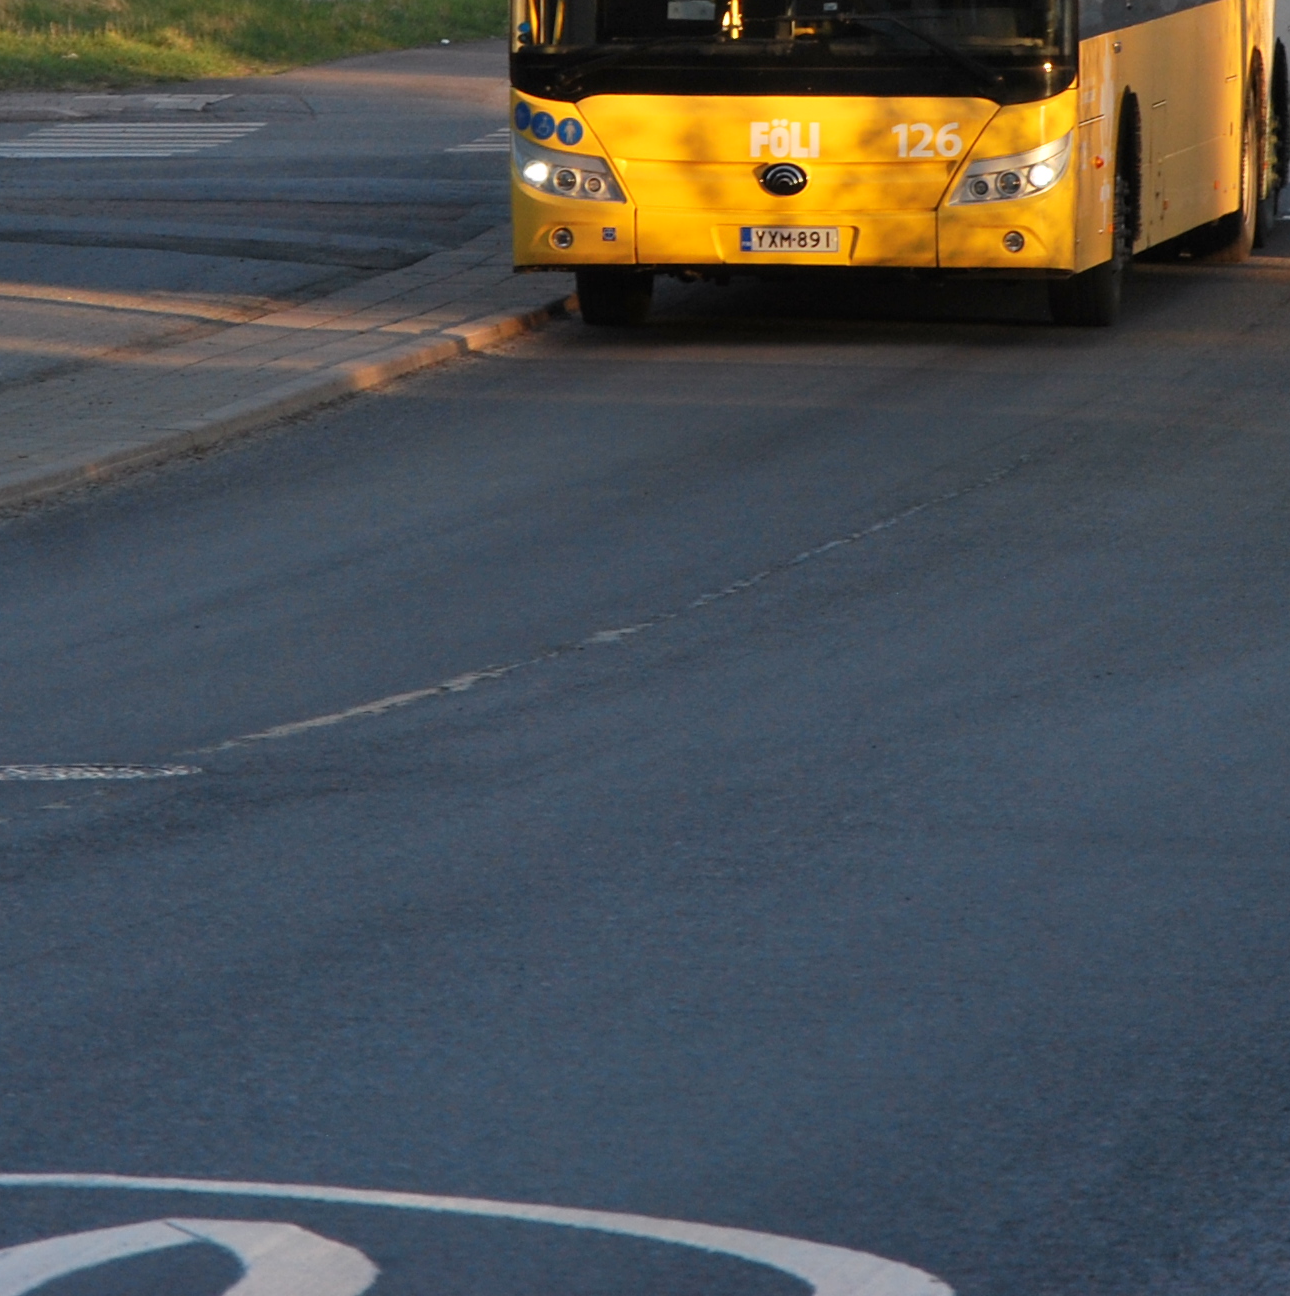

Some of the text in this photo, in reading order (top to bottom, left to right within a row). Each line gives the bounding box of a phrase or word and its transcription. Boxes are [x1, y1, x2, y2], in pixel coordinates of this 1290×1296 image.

[750, 118, 821, 159] FÖLI
[891, 121, 963, 159] 126
[755, 230, 830, 249] YXM-891
